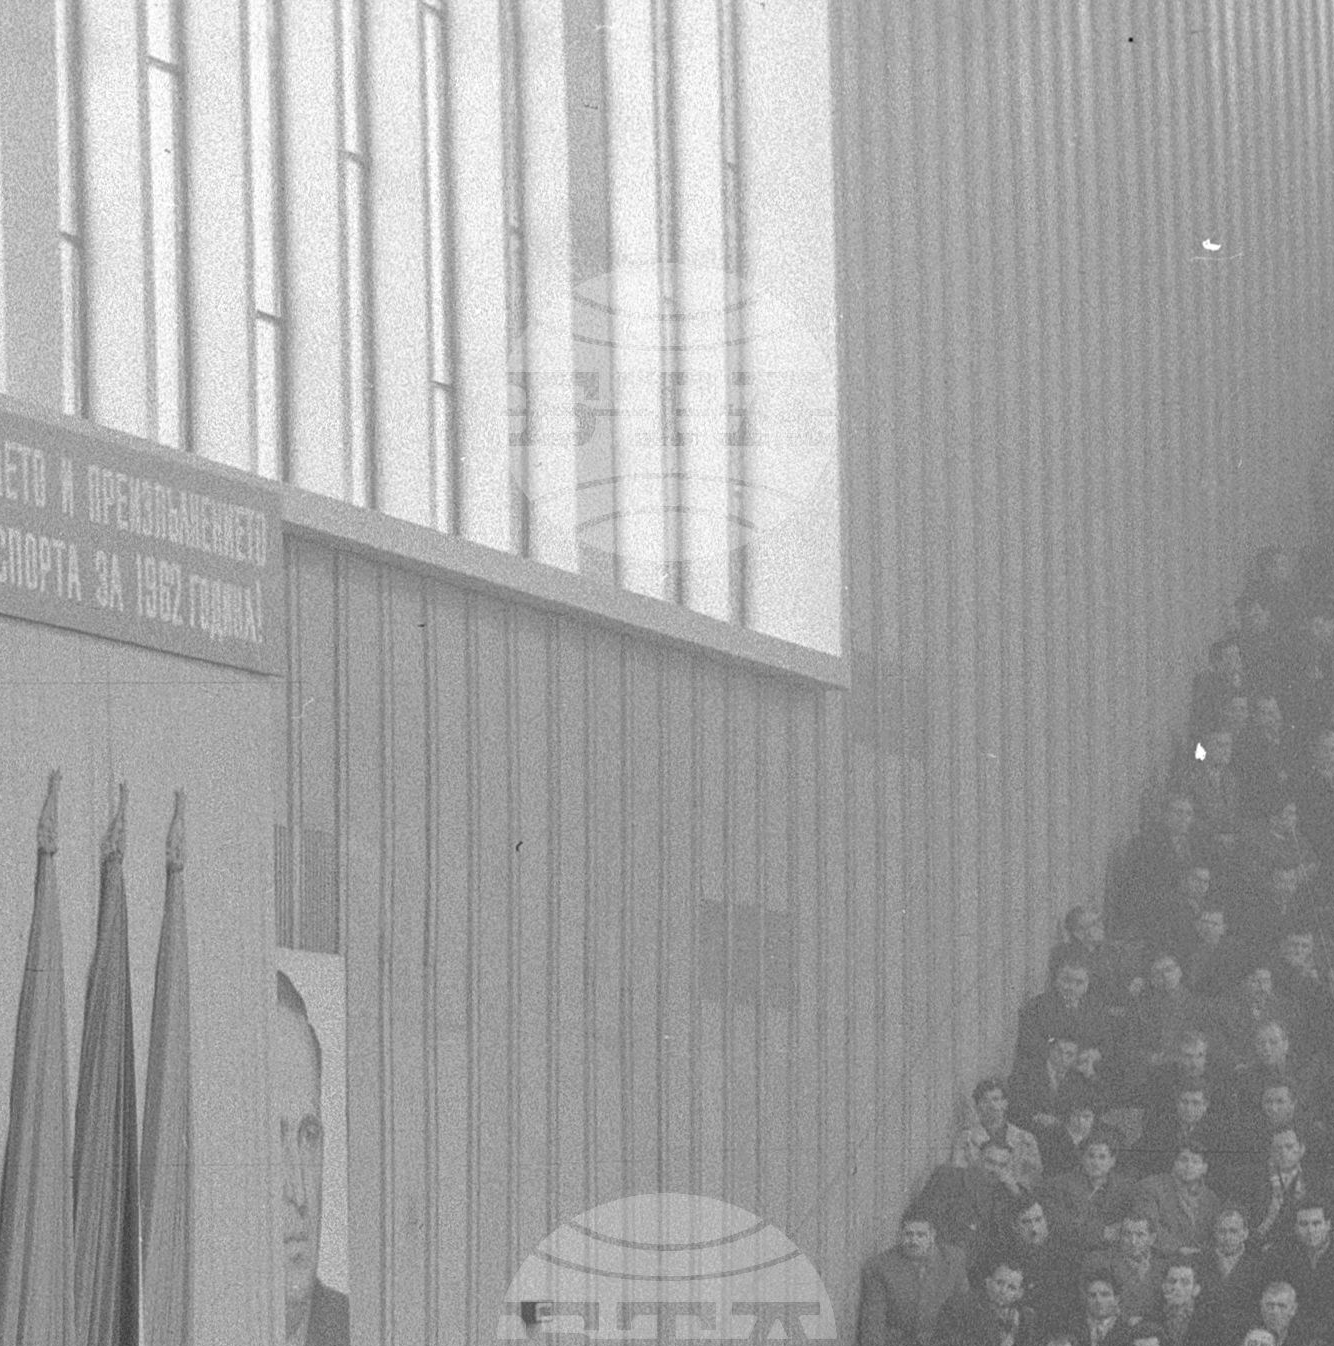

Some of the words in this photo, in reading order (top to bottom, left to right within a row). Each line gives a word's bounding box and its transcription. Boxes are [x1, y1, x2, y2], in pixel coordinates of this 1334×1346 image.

[61, 456, 75, 518] И
[95, 549, 125, 613] ЗА
[136, 552, 184, 626] 1962
